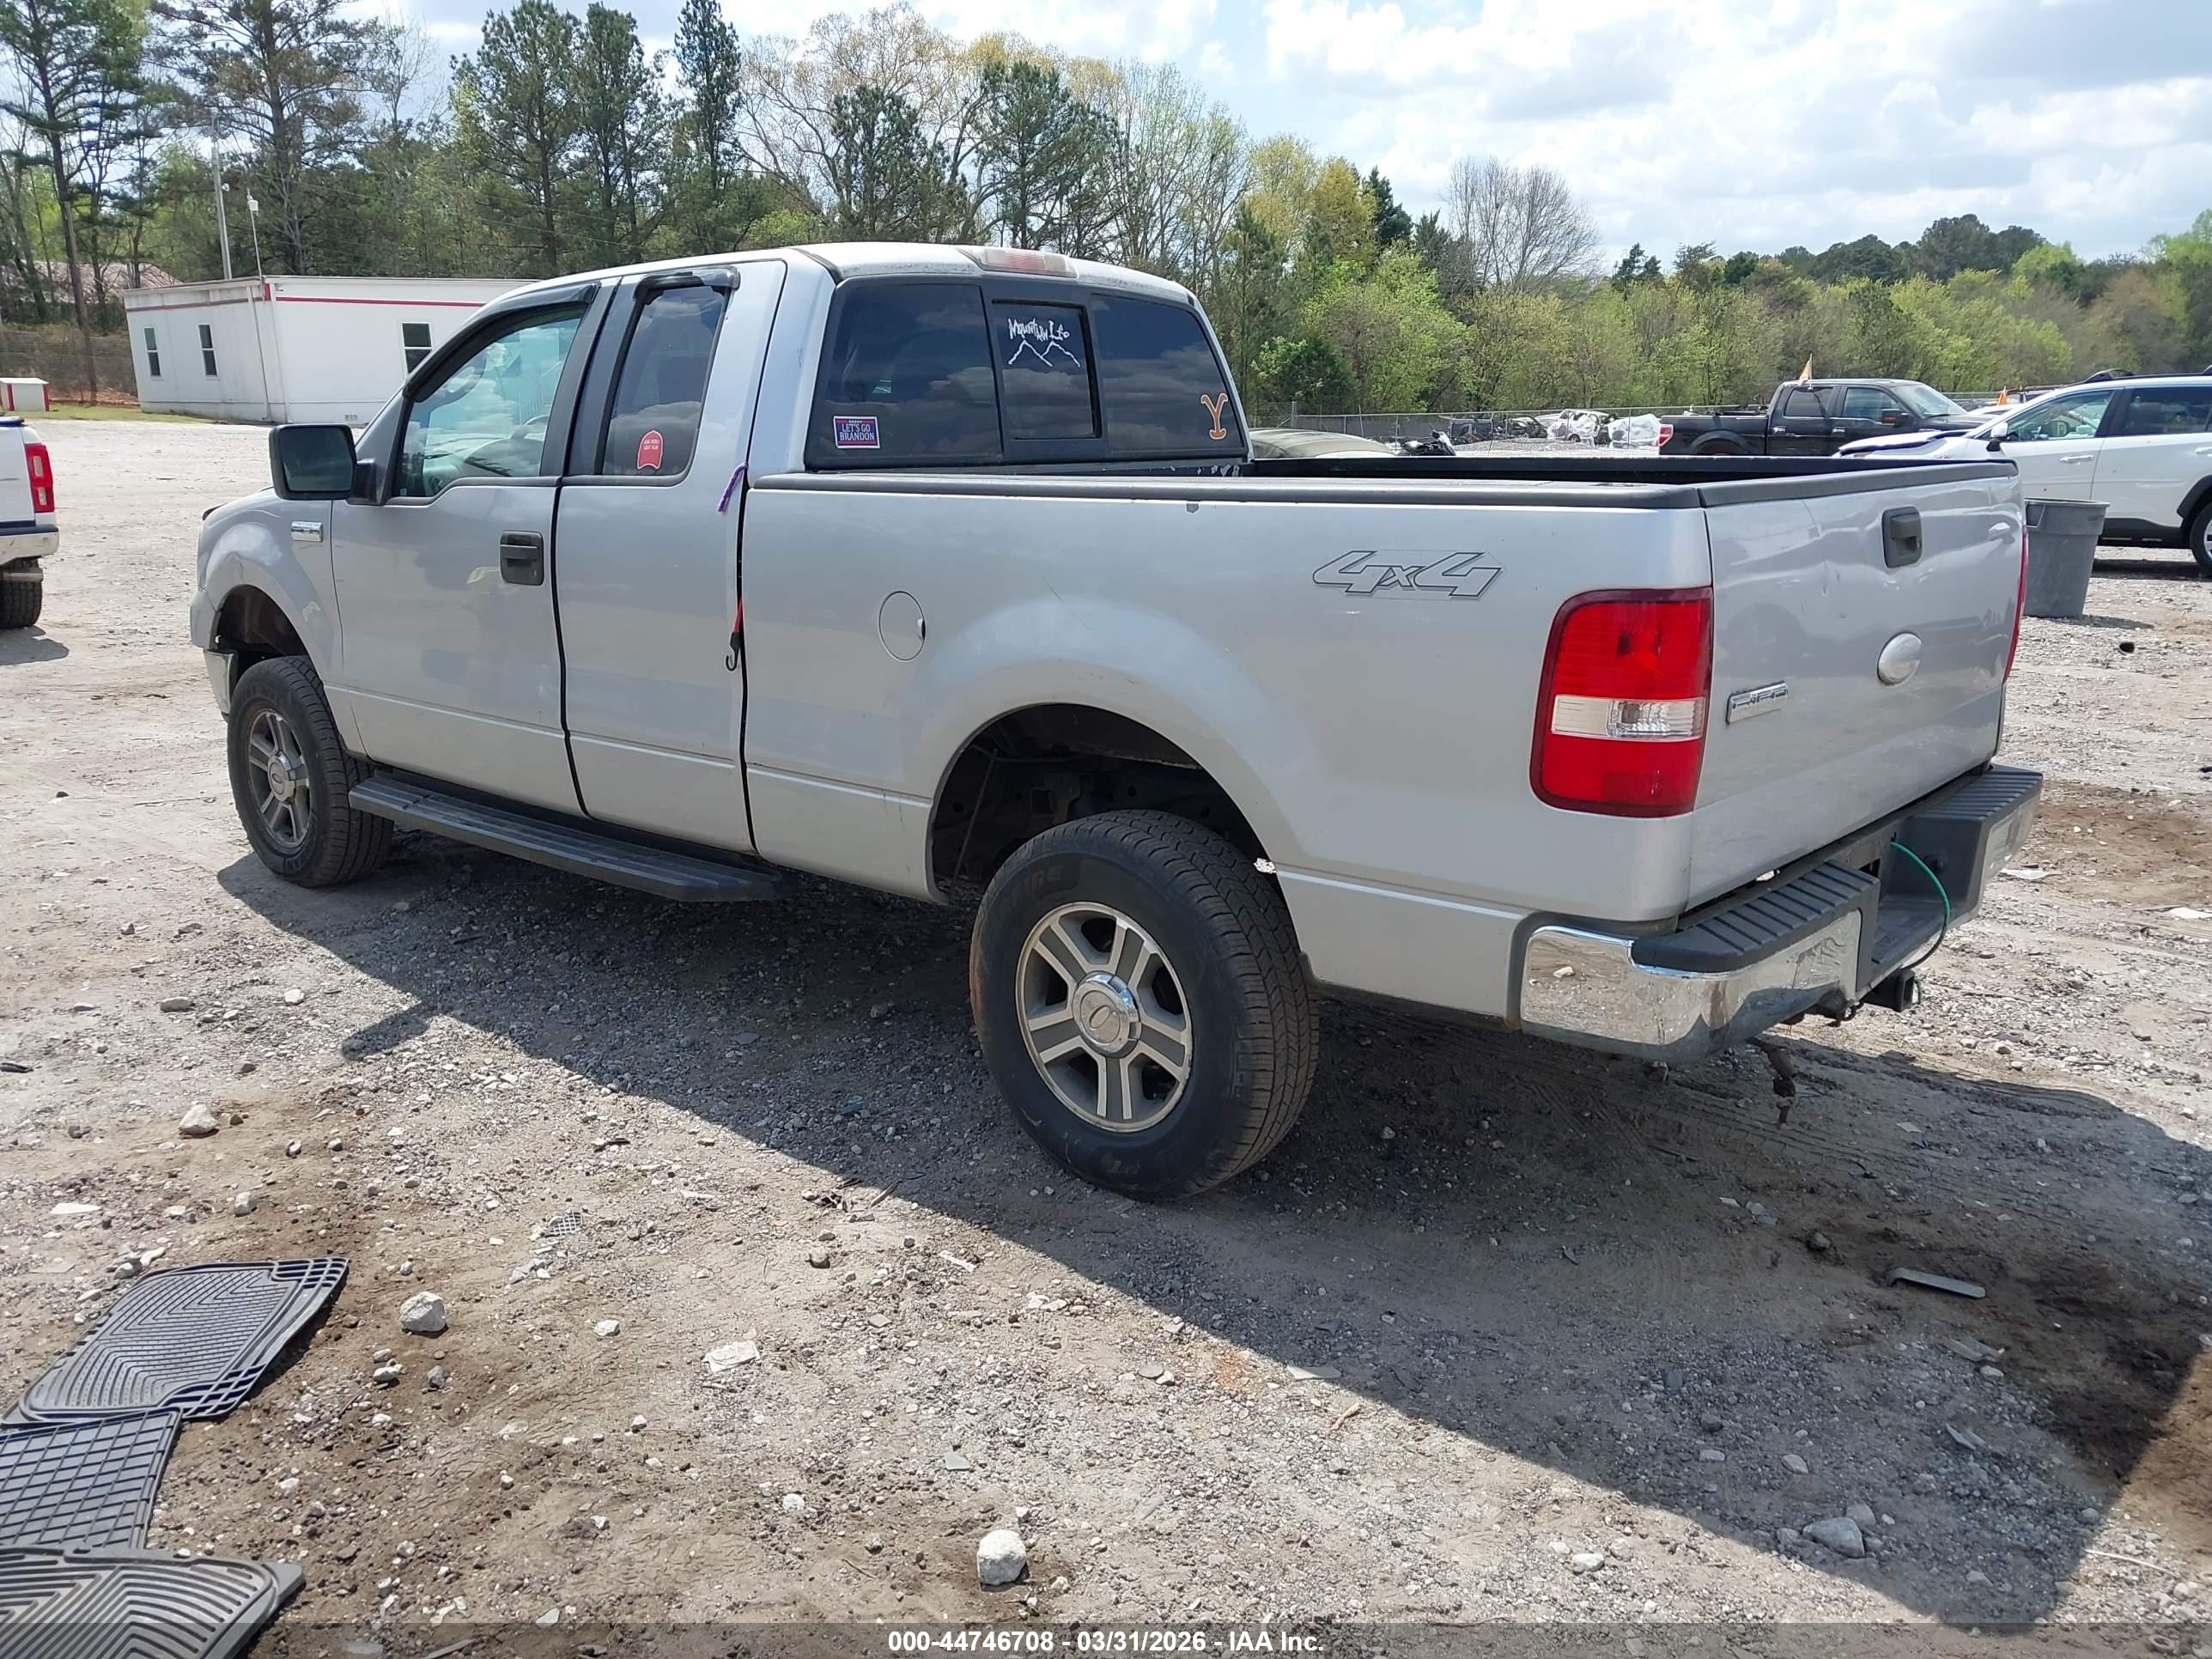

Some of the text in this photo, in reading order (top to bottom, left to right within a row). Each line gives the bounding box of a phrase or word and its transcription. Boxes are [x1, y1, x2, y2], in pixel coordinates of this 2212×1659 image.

[842, 423, 871, 432] LET'S GO
[840, 432, 875, 441] BRANDON
